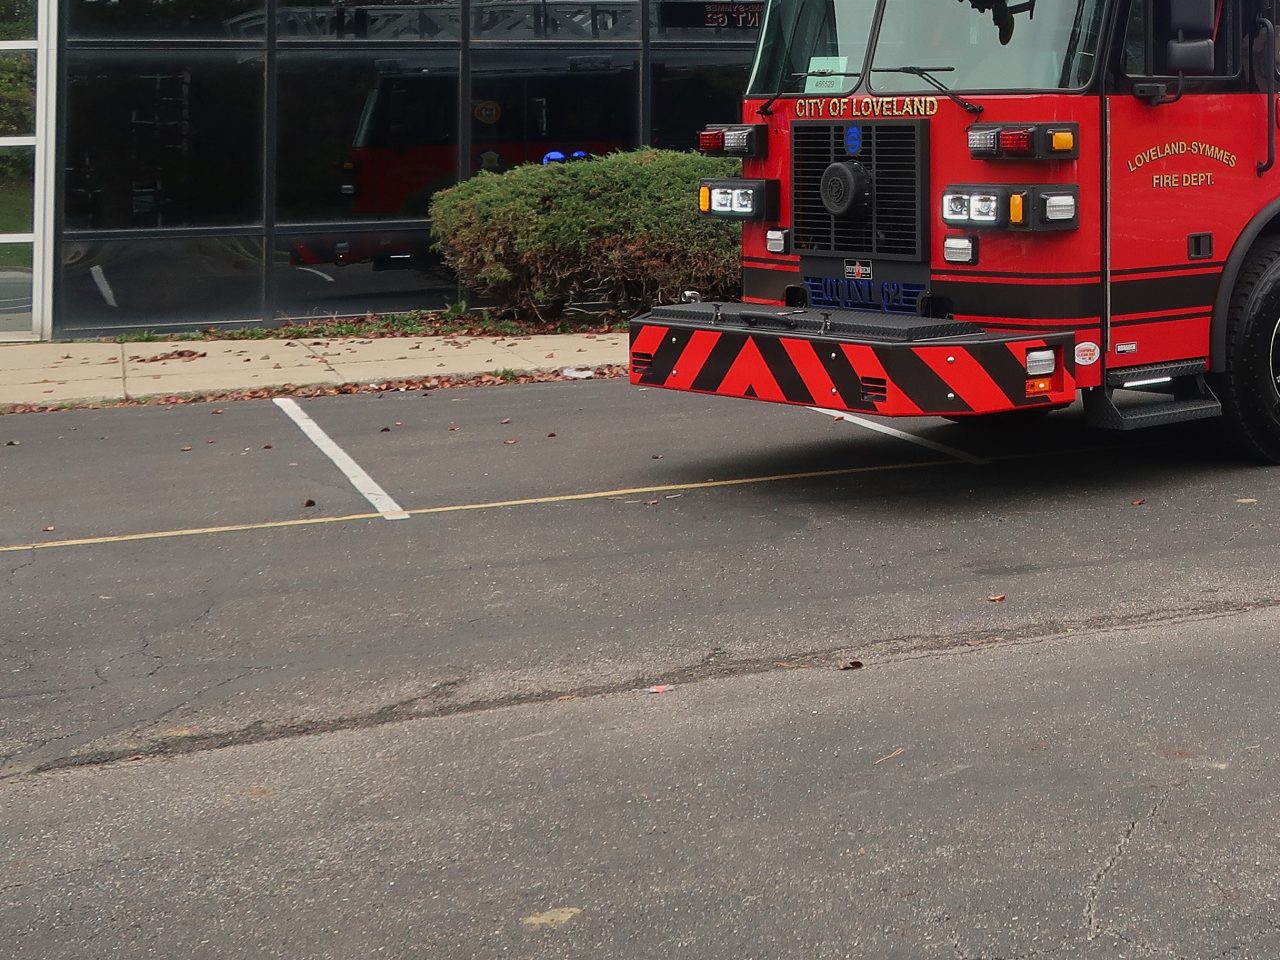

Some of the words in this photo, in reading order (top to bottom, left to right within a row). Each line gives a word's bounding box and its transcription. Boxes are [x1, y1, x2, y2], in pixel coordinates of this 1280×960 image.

[795, 98, 825, 117] CITY
[829, 98, 849, 117] OF
[851, 96, 938, 117] LOVELAND
[1127, 141, 1237, 172] LOVELAND-SYMMES
[1152, 174, 1179, 188] FIRE
[1182, 173, 1214, 186] DEPT.
[881, 281, 901, 306] 62
